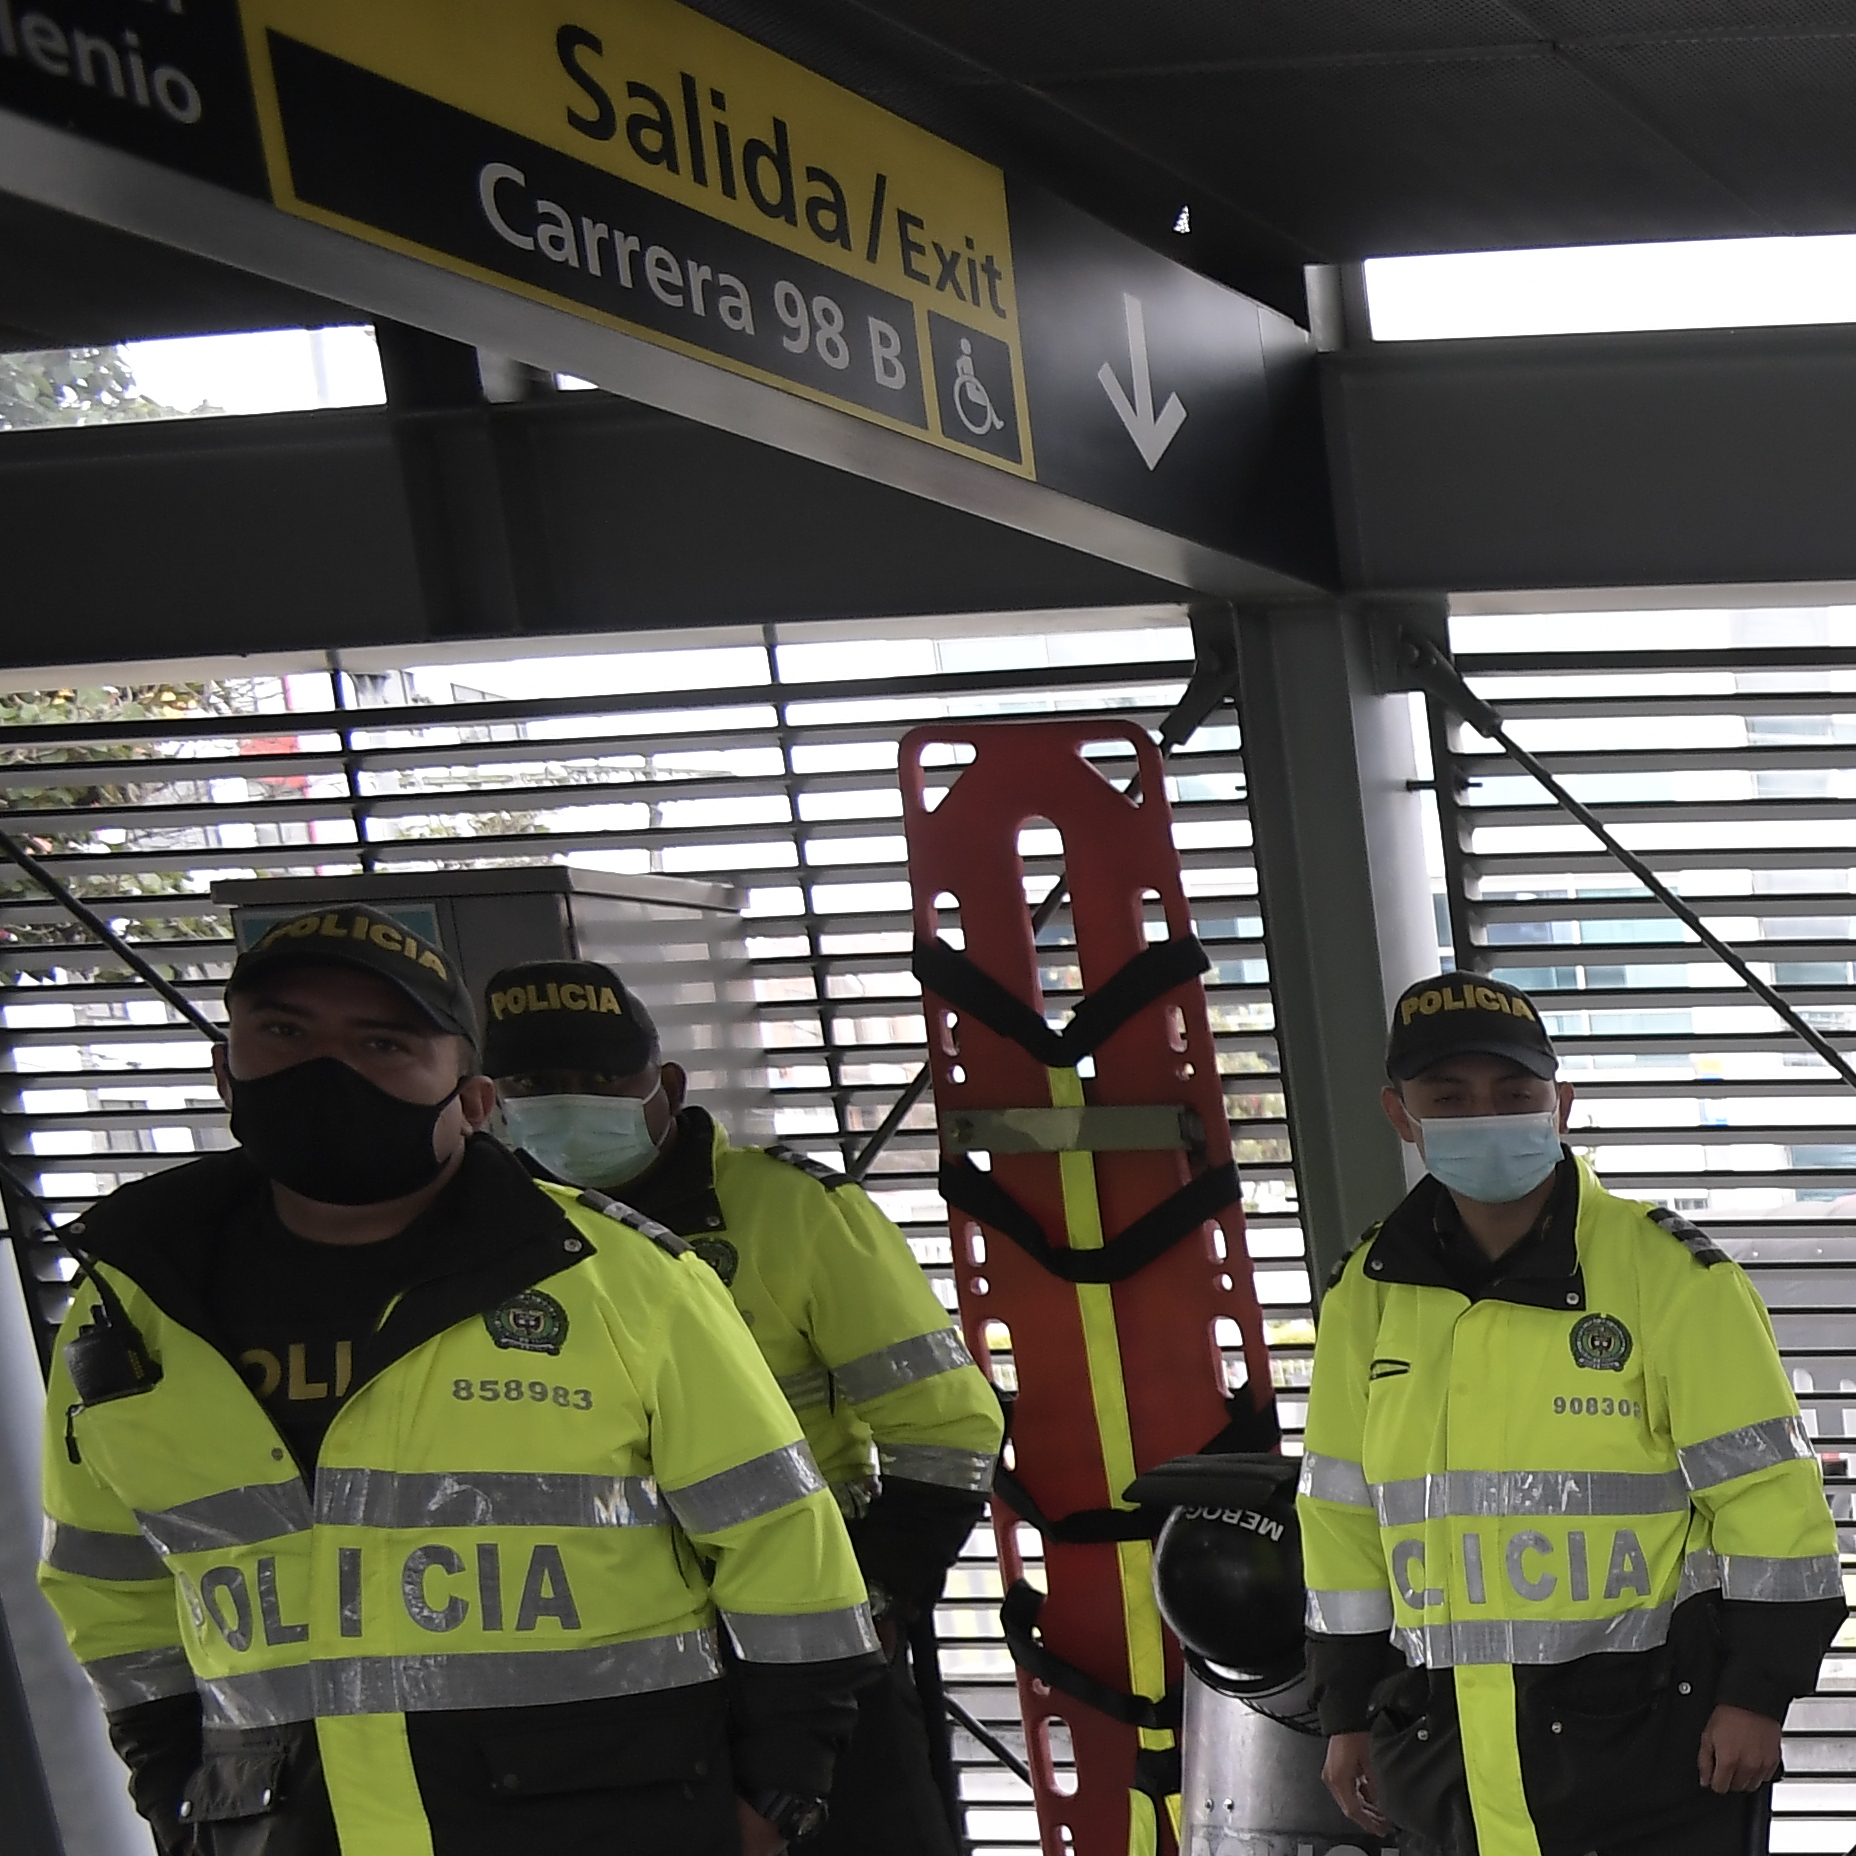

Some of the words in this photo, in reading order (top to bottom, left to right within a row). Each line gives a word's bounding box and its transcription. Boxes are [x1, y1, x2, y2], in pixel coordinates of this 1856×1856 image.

[479, 162, 755, 336] Carrera
[773, 280, 850, 370] 98
[867, 315, 906, 390] B
[491, 982, 623, 1021] POLICIA
[1401, 984, 1536, 1025] POLICIA
[452, 1378, 594, 1411] 858983
[177, 1543, 582, 1653] OLICIA
